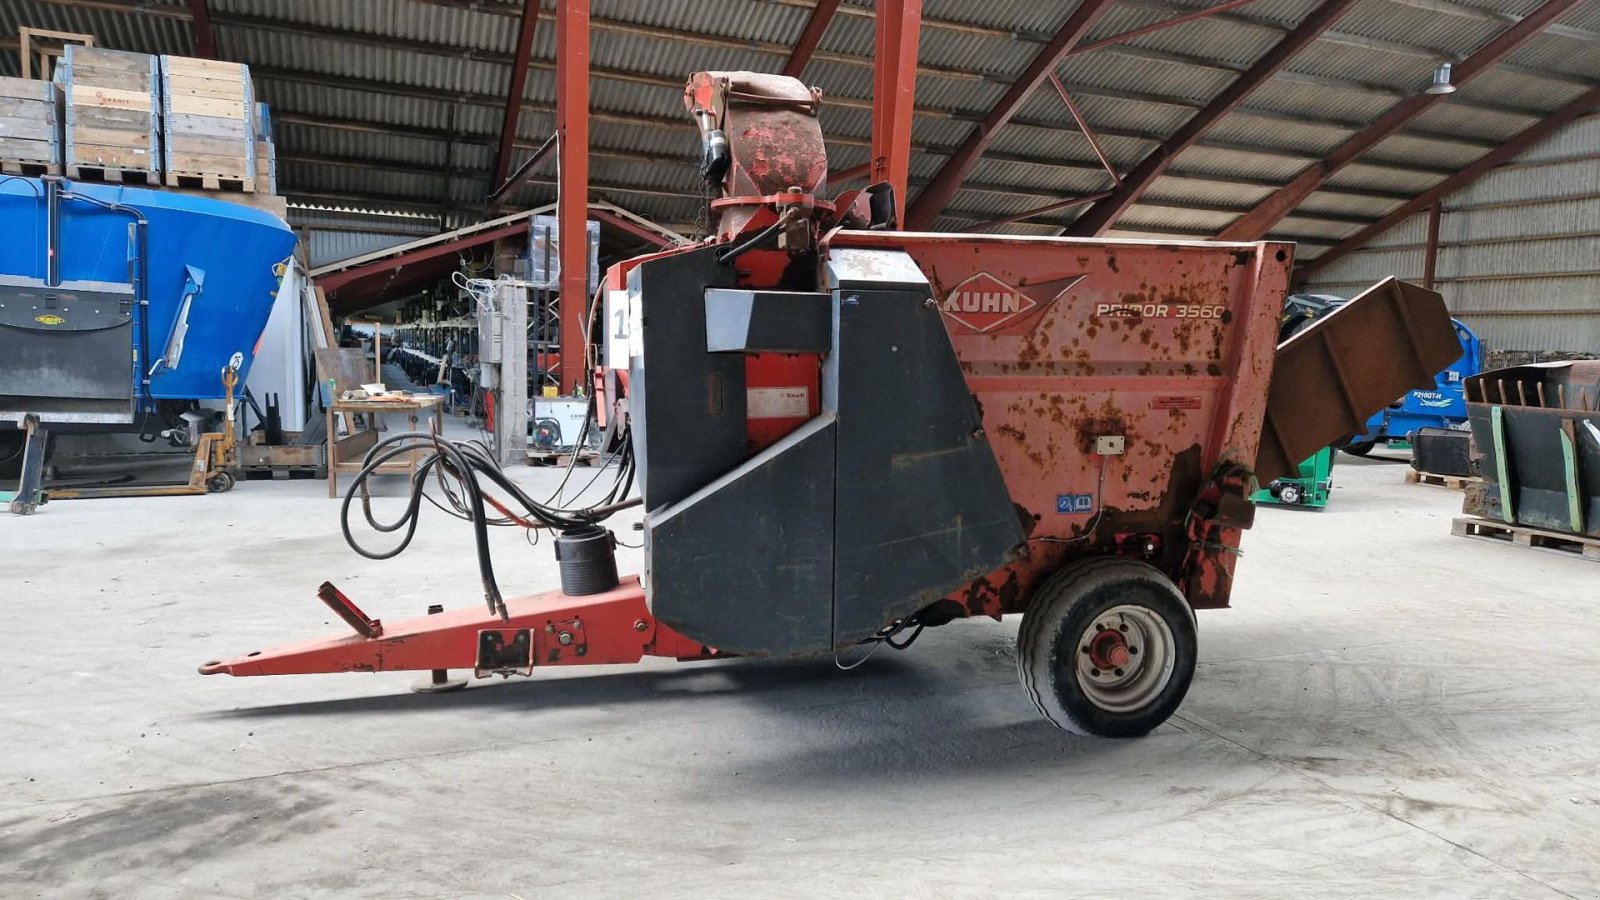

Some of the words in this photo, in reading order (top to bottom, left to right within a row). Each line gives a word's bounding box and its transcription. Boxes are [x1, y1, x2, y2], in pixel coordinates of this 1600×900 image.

[943, 291, 1020, 313] KUHN
[1096, 303, 1169, 318] PRIMOR
[1175, 304, 1226, 319] 3560
